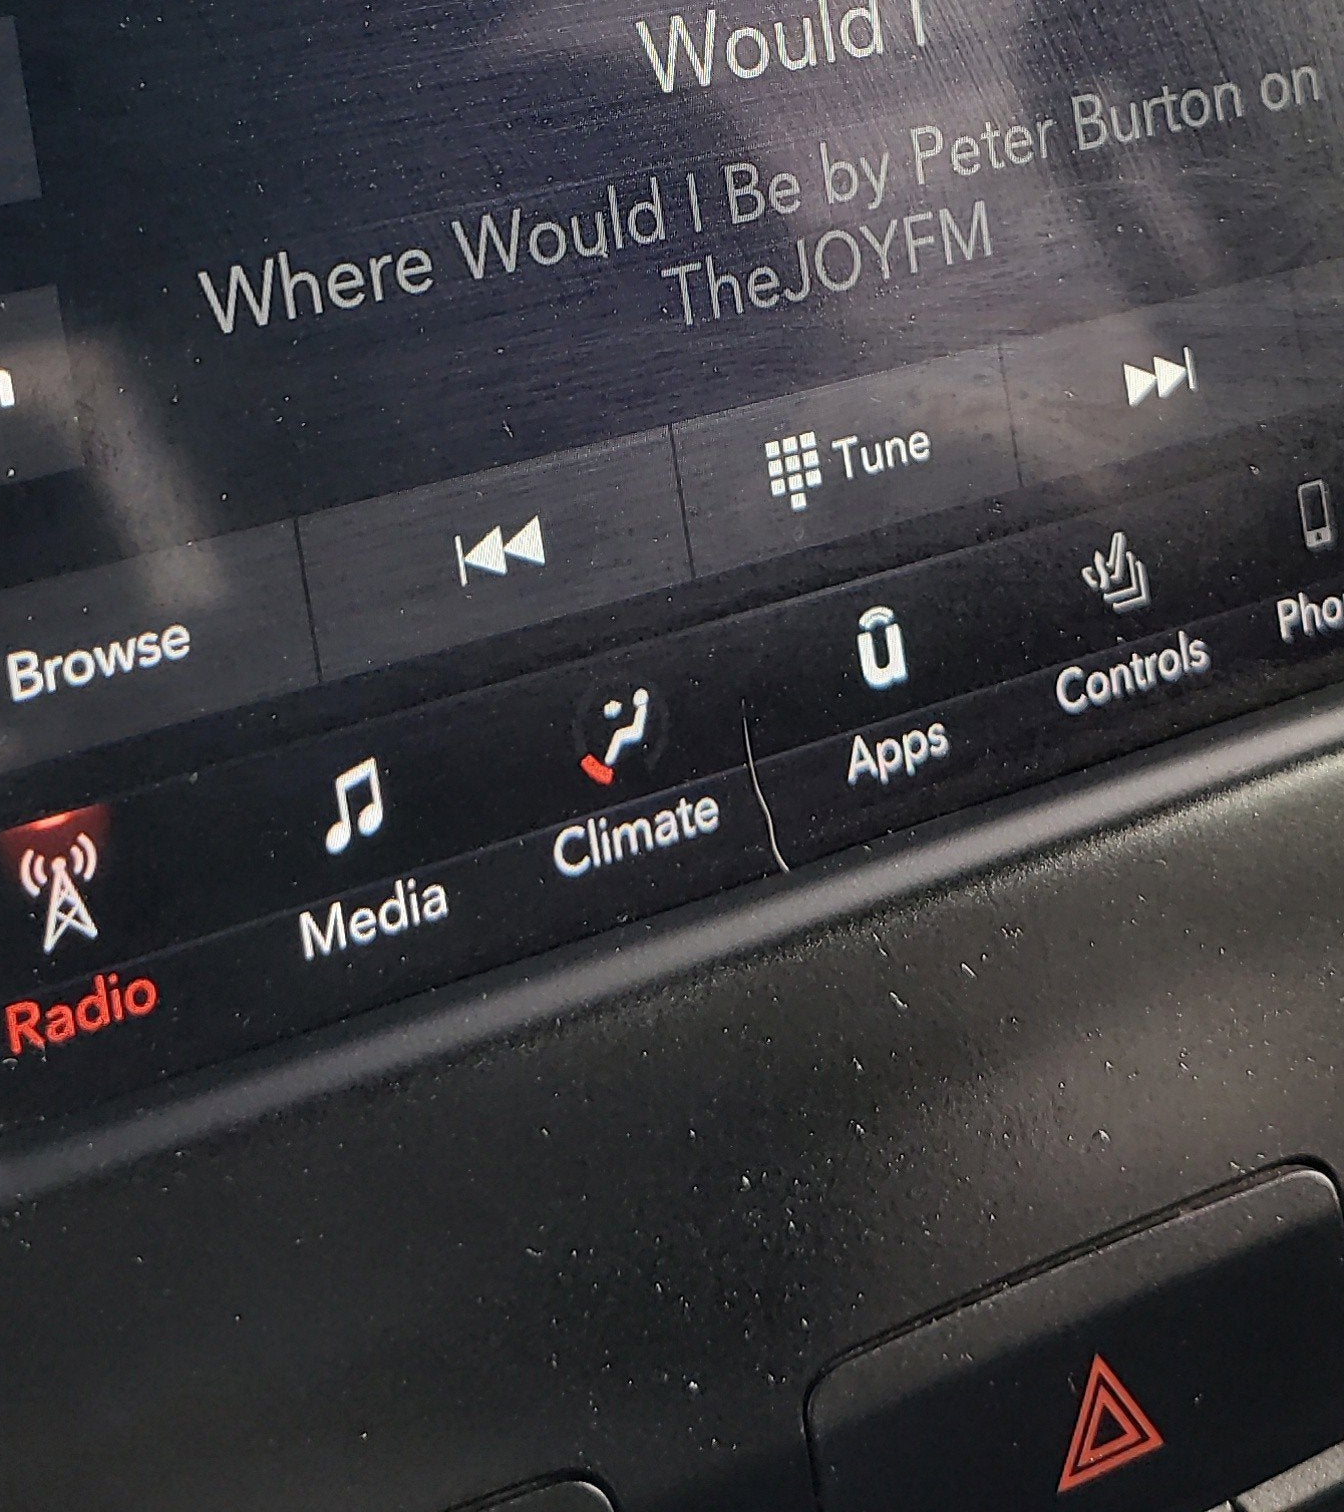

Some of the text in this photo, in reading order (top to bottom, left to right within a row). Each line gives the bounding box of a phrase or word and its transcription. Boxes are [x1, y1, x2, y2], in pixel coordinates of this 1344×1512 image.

[199, 62, 1320, 335] Where Would I Be by Peter Burton on
[662, 200, 992, 327] TheJOYFM
[831, 430, 931, 485] Tune
[6, 622, 191, 703] Browse
[1057, 630, 1211, 715] Controls
[847, 719, 948, 785] Apps
[553, 796, 720, 878] Climate
[299, 879, 449, 961] Media
[4, 974, 158, 1056] Radio
